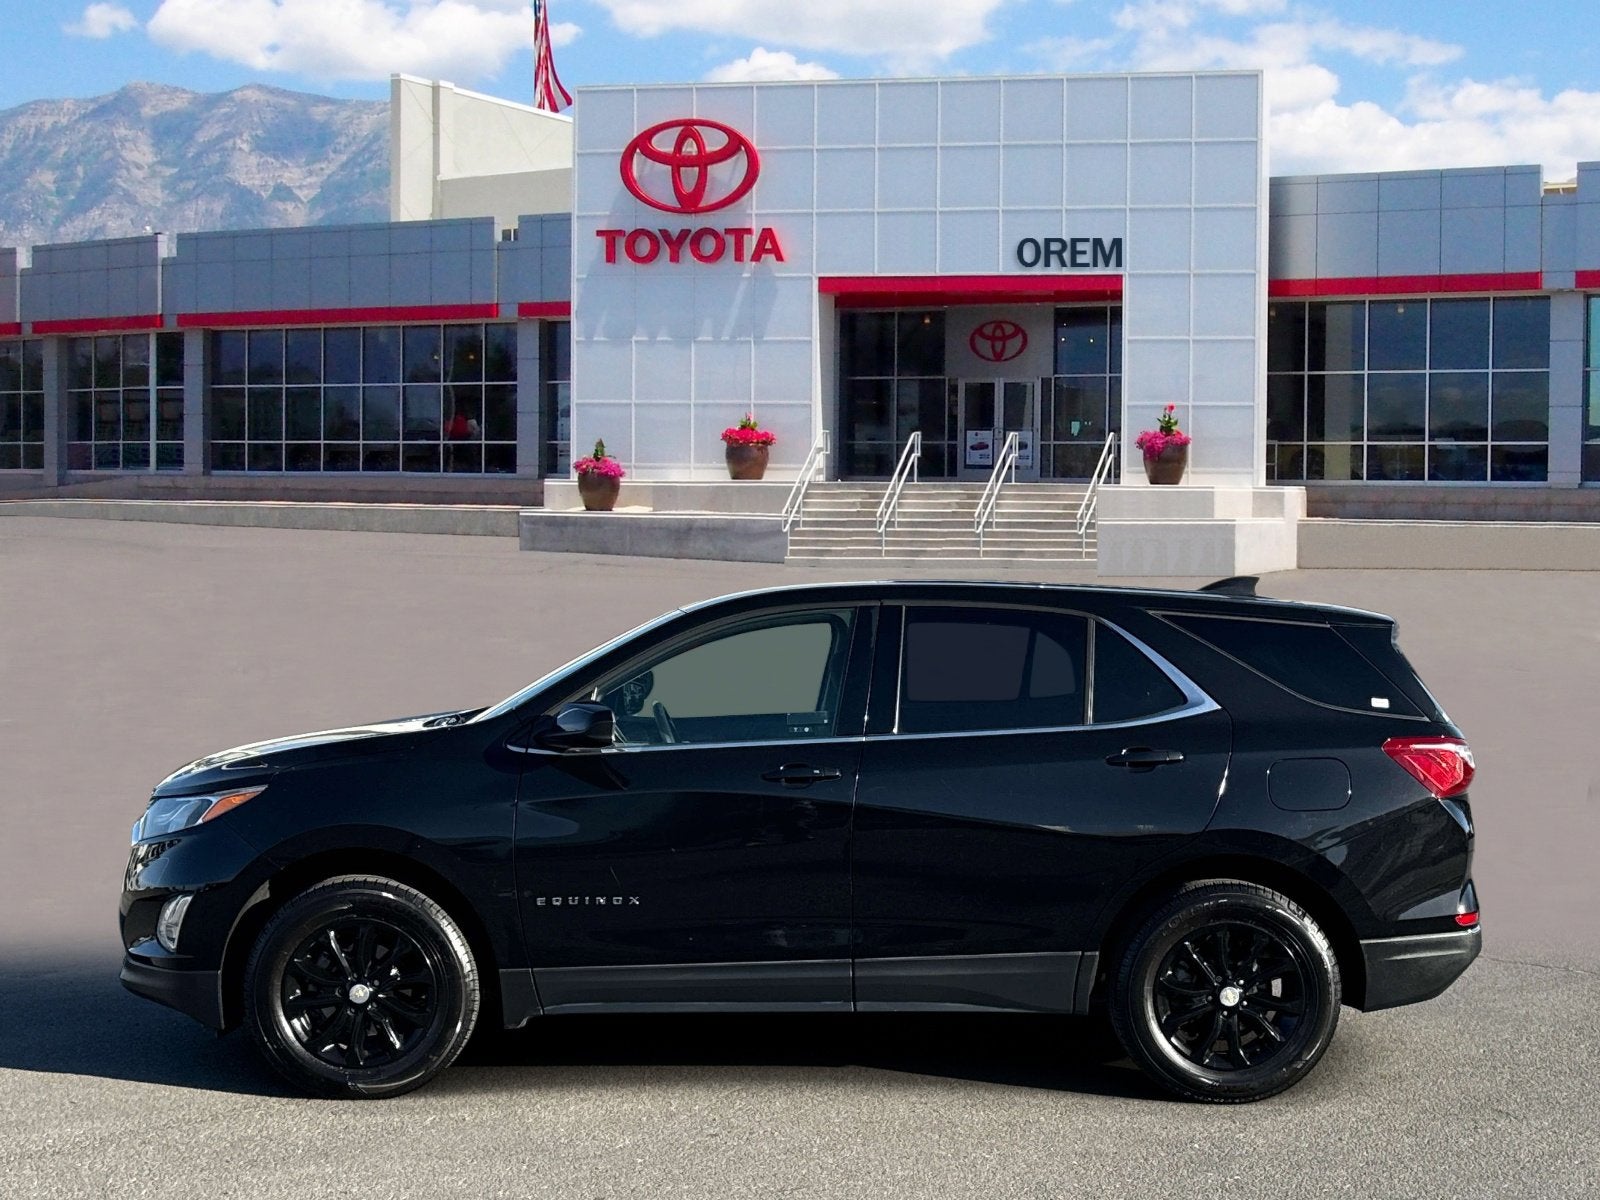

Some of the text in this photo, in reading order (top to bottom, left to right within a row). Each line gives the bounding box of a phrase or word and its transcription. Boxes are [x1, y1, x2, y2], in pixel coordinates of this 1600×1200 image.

[596, 227, 784, 263] TOYOTA
[1016, 237, 1123, 268] OREM
[536, 896, 640, 906] EQUINOX
